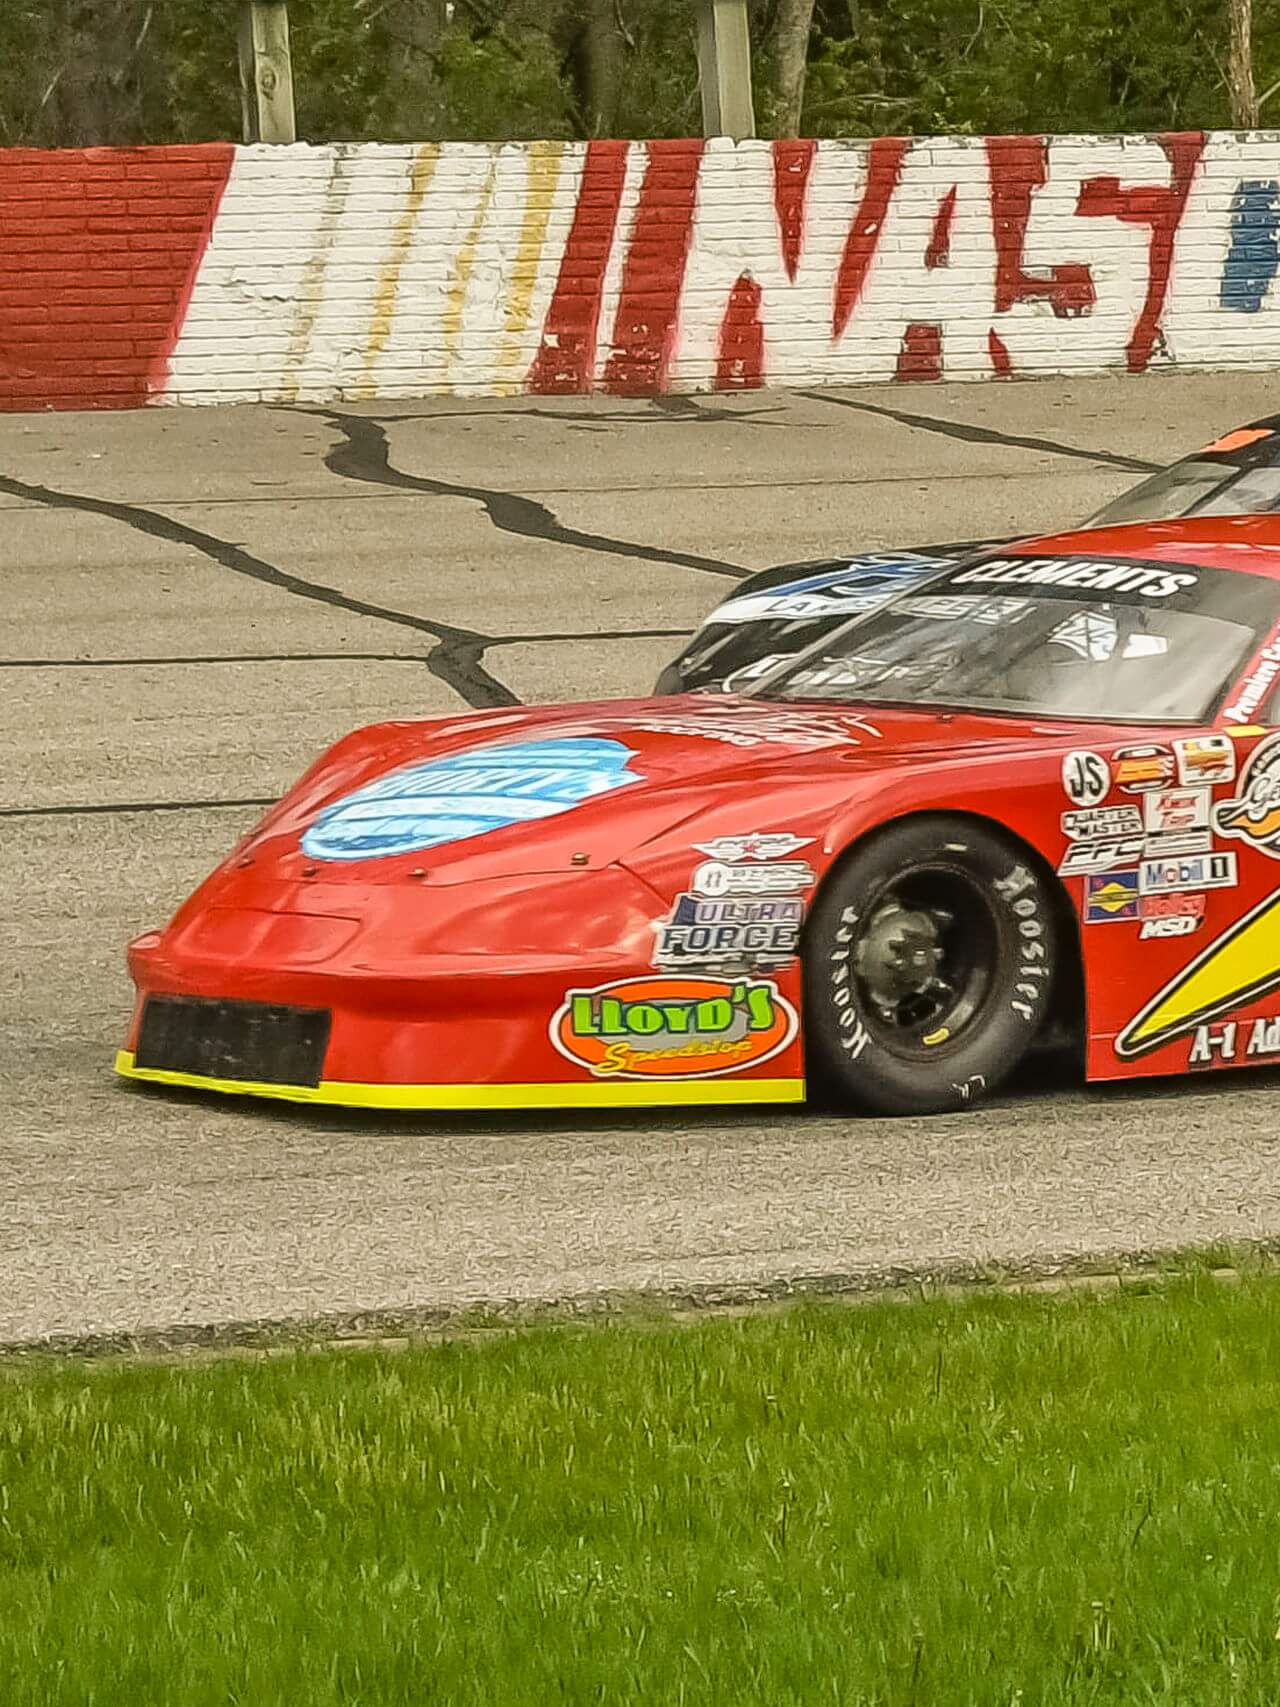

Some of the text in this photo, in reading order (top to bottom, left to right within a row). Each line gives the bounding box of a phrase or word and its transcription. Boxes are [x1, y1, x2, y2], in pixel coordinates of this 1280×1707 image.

[951, 559, 1199, 597] CLEMENTS
[698, 901, 801, 923] ULTRA
[660, 924, 799, 952] FORCE
[1188, 1022, 1237, 1063] A-1
